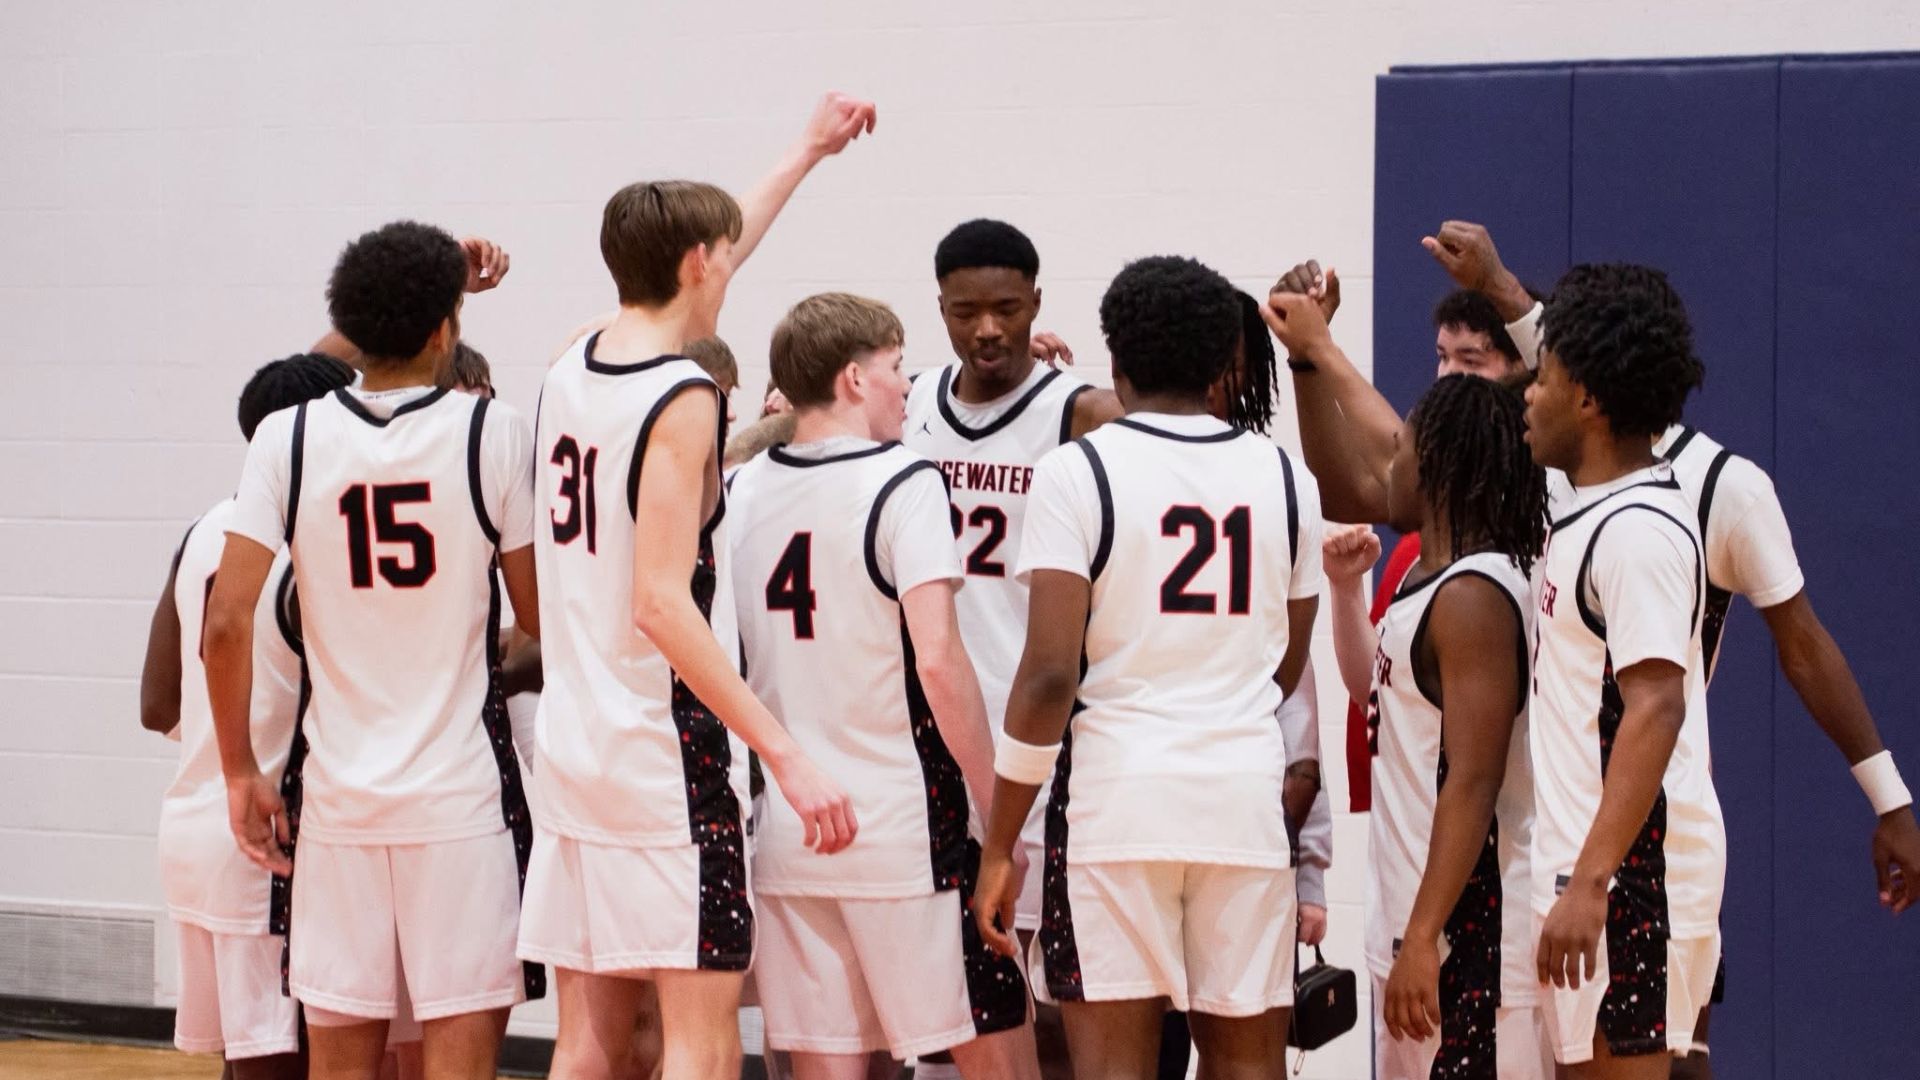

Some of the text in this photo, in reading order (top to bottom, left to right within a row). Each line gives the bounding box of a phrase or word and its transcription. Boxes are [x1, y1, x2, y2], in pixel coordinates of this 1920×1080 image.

[549, 432, 599, 556] 31
[938, 460, 1034, 495] GEWATER
[338, 480, 437, 590] 15
[764, 530, 817, 641] 4
[1159, 503, 1252, 616] 21
